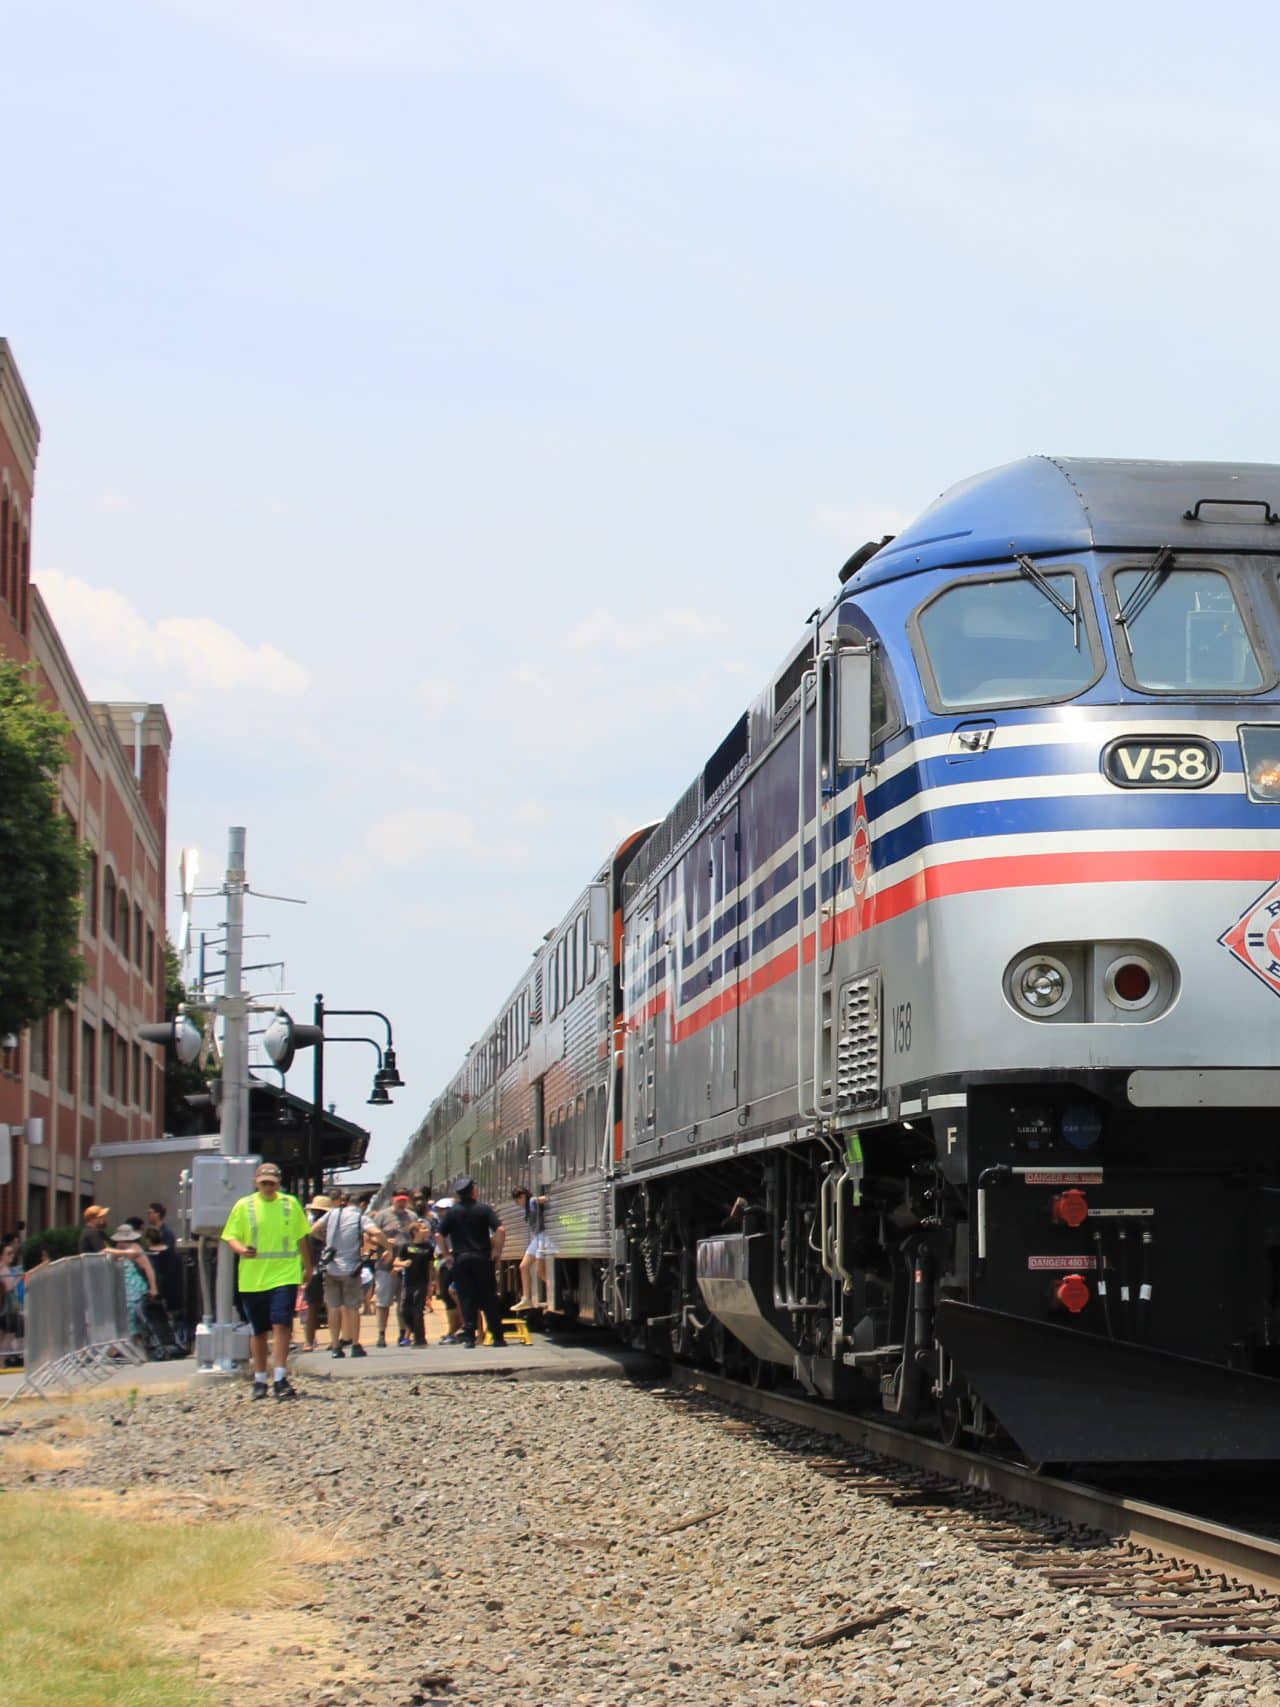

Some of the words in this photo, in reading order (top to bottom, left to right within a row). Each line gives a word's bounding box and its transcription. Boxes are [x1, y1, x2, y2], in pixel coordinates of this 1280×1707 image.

[1118, 748, 1206, 780] V58
[892, 1002, 912, 1054] V58
[947, 1126, 957, 1155] F
[1031, 1258, 1067, 1267] DANGER
